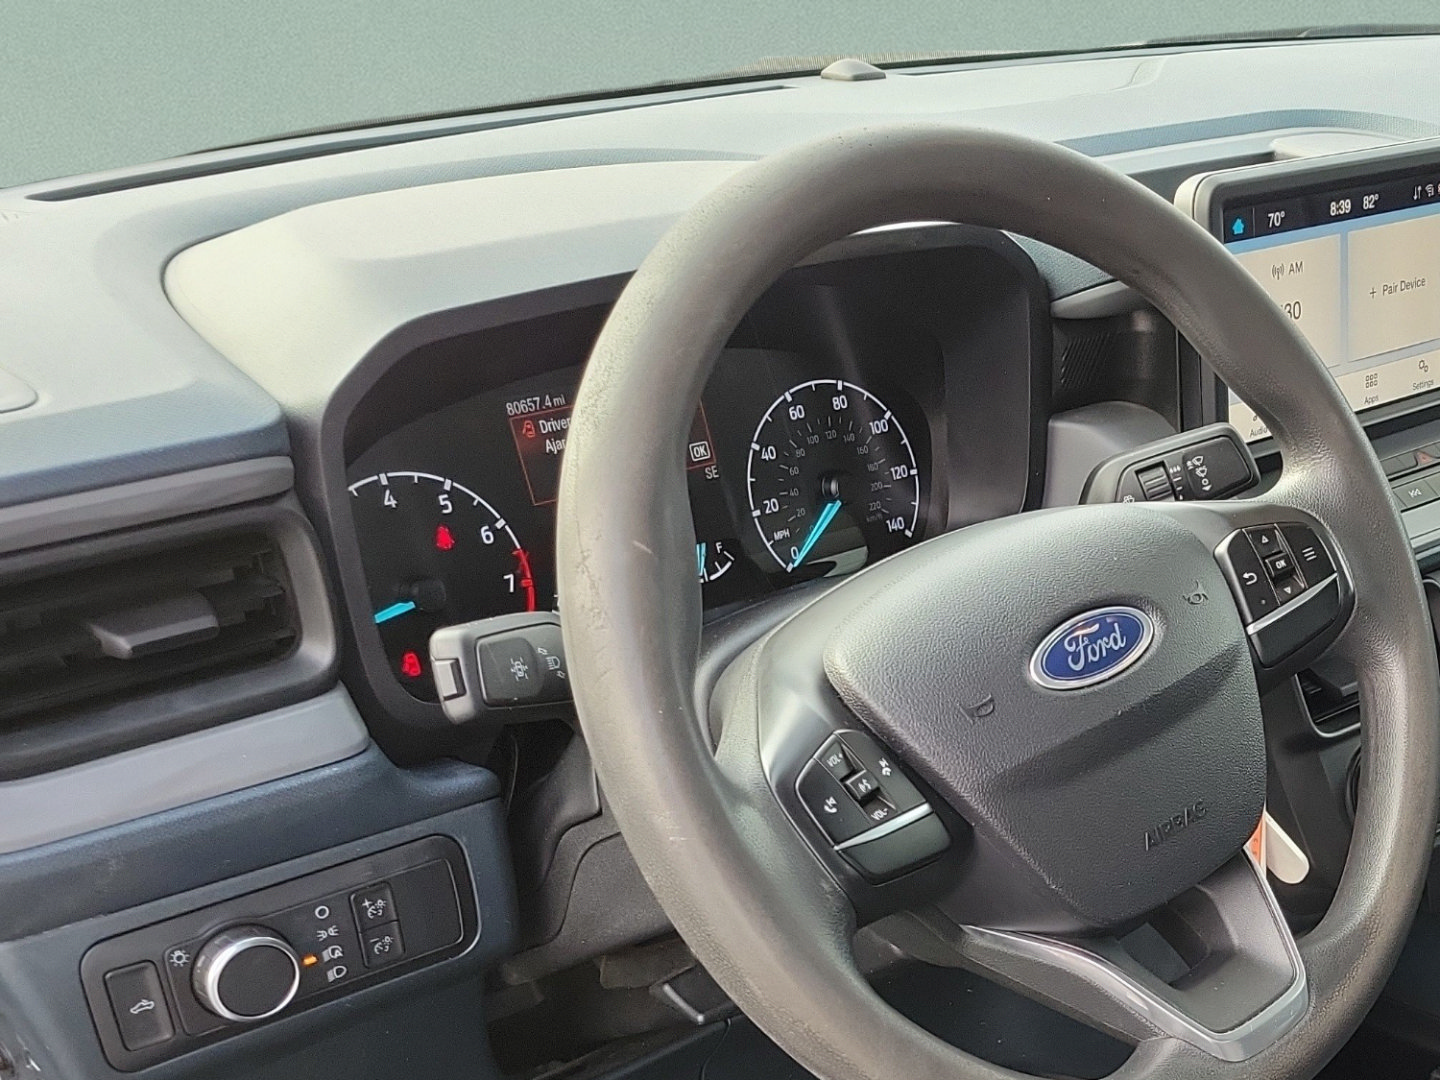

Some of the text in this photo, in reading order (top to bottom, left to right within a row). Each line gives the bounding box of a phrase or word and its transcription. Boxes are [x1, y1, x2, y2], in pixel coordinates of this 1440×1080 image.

[1267, 194, 1379, 228] 70° 8:39 82°
[1288, 261, 1304, 275] AM
[1382, 277, 1426, 296] Pair Device
[1412, 379, 1434, 391] Settings
[506, 394, 566, 416] 80657.4 mi
[832, 395, 848, 411] 80
[1364, 395, 1379, 405] Apps
[788, 405, 805, 421] 60
[539, 418, 571, 434] Driver
[869, 419, 889, 435] 100
[807, 435, 819, 445] 100
[825, 430, 837, 440] 120
[843, 433, 855, 443] 140
[693, 446, 707, 458] OK
[760, 445, 777, 461] 40
[704, 466, 719, 479] SE
[789, 466, 799, 476] 60
[890, 465, 908, 481] 120
[789, 488, 799, 497] 40
[870, 481, 883, 491] 200
[384, 489, 398, 508] 4
[438, 494, 453, 514] 5
[763, 498, 780, 514] 20
[796, 508, 806, 517] 20
[886, 516, 905, 533] 140
[480, 525, 494, 545] 6
[773, 528, 790, 541] MPH
[715, 542, 723, 554] F
[790, 546, 800, 560] 0
[1275, 559, 1287, 569] OK
[503, 573, 515, 593] 7
[1064, 623, 1126, 671] Ford
